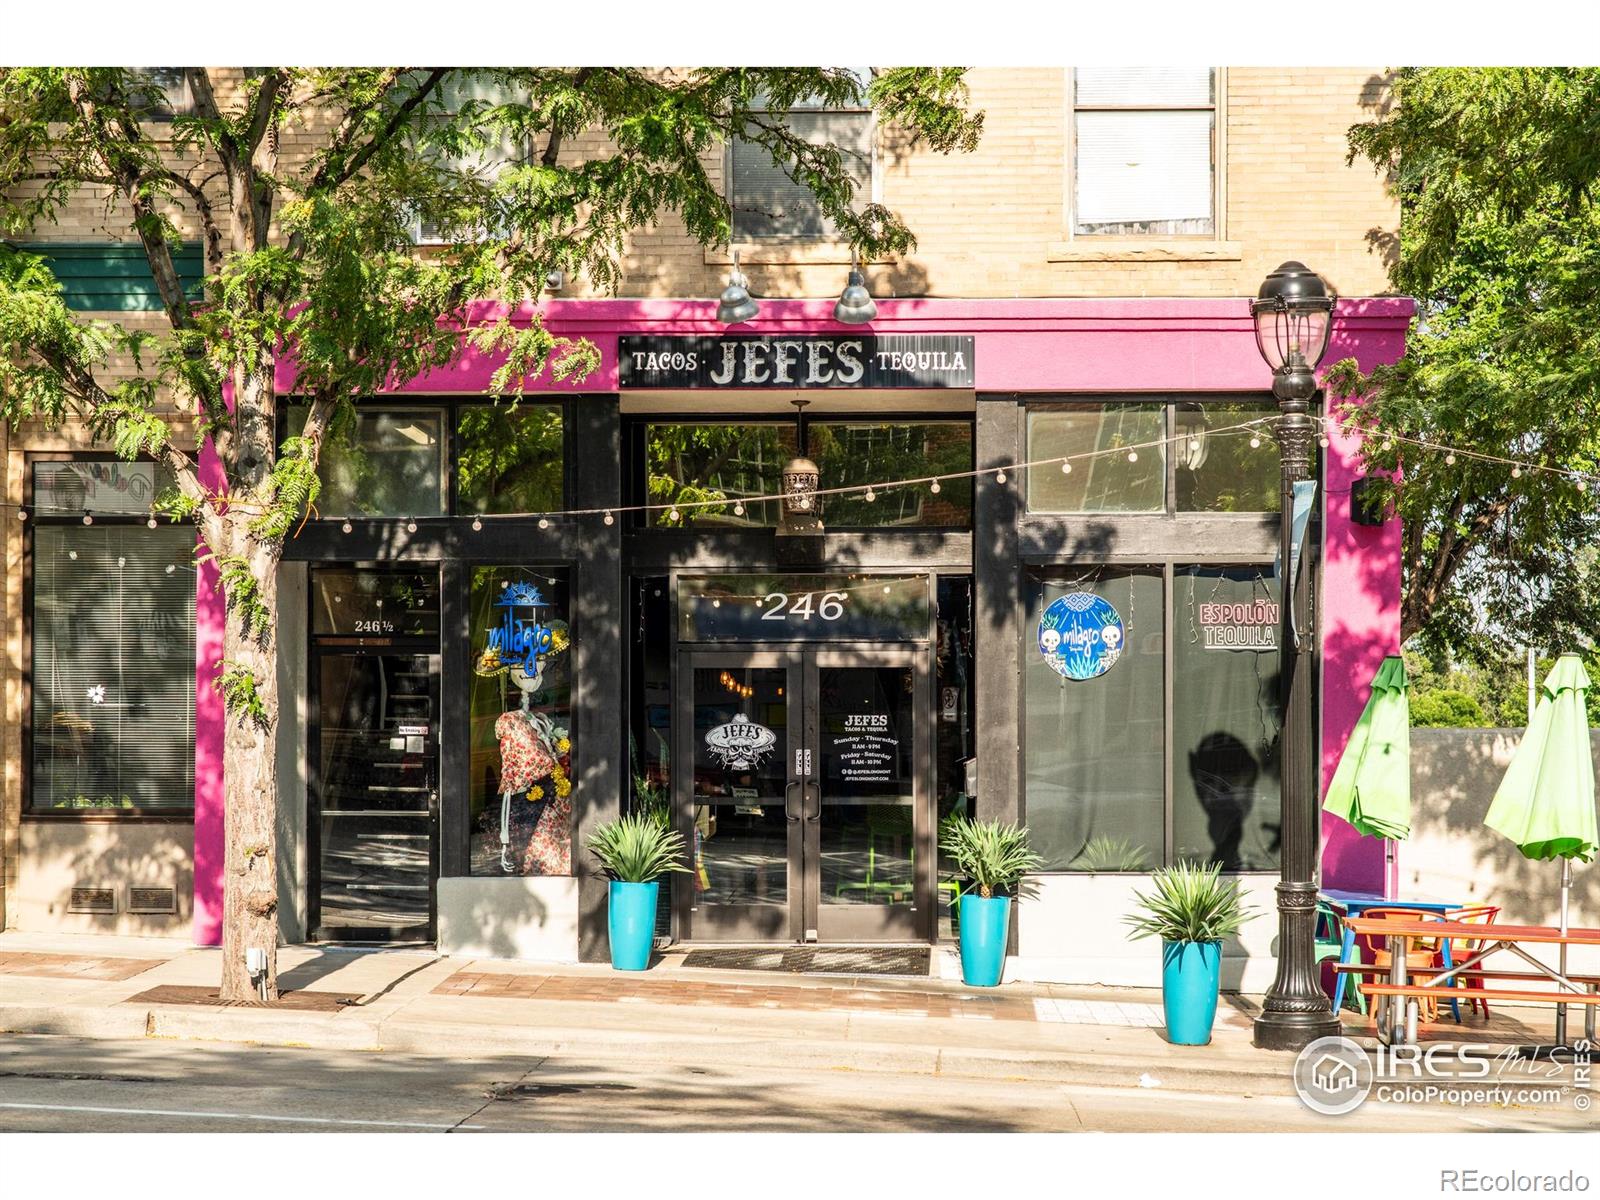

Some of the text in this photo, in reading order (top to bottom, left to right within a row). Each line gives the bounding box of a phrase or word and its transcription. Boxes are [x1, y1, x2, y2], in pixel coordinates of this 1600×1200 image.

[633, 341, 967, 385] TACOS JEFES TEQUILA
[761, 592, 845, 621] 246
[354, 620, 381, 633] 246
[1063, 619, 1100, 658] milagro
[1204, 625, 1275, 646] TEQUILA
[845, 715, 888, 726] JEFES
[722, 724, 762, 740] JEFES
[833, 736, 860, 745] Sunday
[865, 735, 899, 746] Thursday
[840, 752, 860, 760] Friday
[864, 751, 892, 760] Saturday
